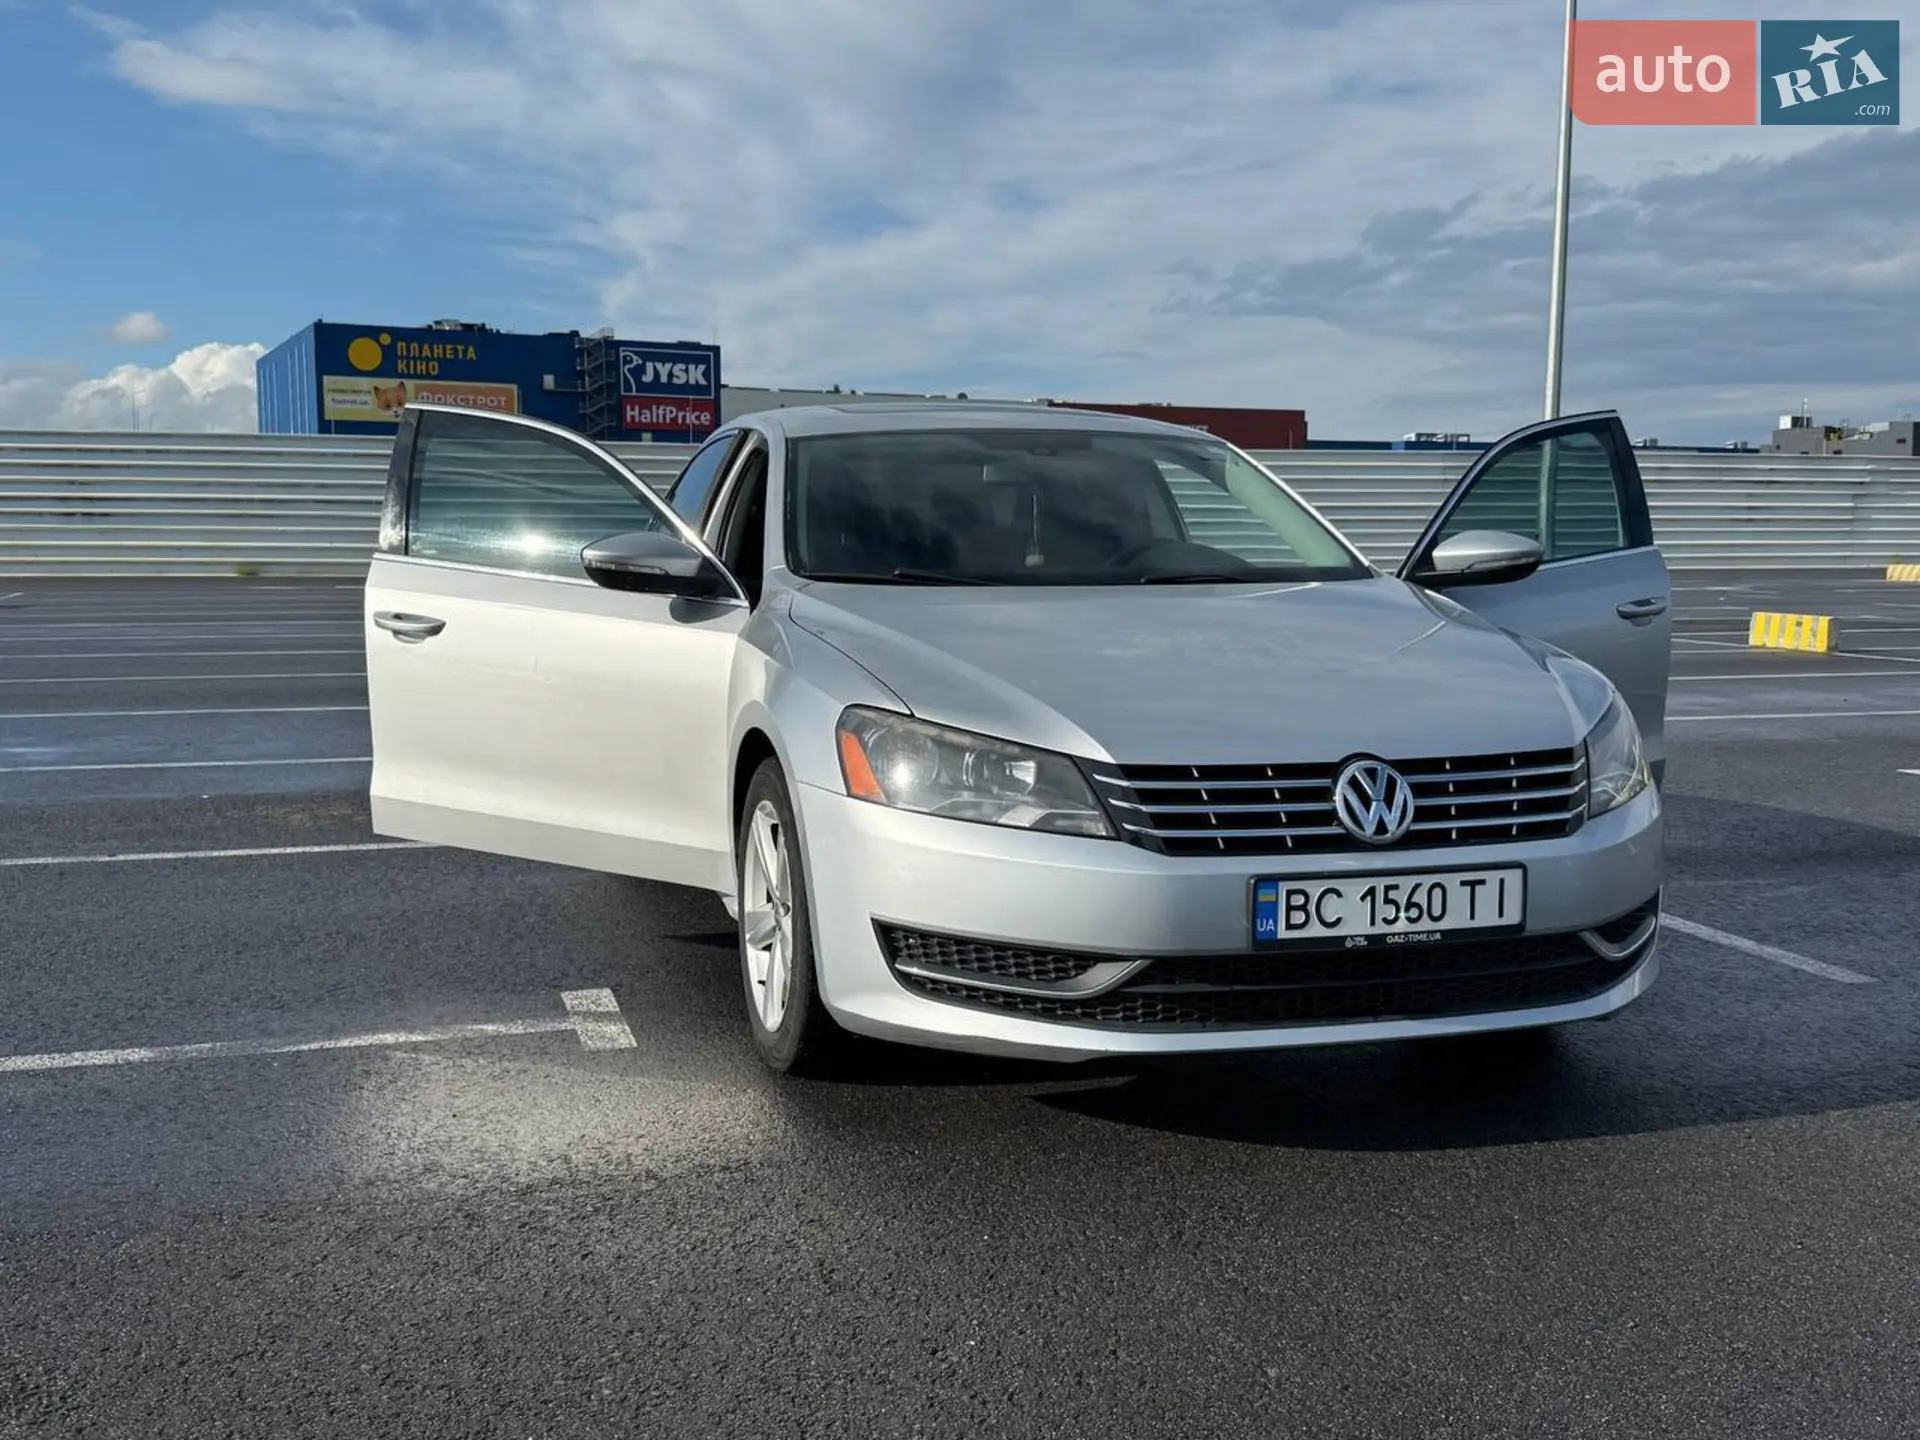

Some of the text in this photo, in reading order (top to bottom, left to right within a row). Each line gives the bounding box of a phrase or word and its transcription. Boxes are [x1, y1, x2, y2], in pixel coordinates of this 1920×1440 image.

[397, 341, 477, 361] ПЛАНЕТА
[397, 358, 439, 376] КІНО
[641, 361, 708, 385] JYSK
[418, 391, 508, 407] ФОКСТРОТ
[626, 404, 711, 425] HalfPrice
[1284, 887, 1344, 931] BC
[1359, 882, 1447, 927] 1560
[1256, 918, 1276, 932] UA
